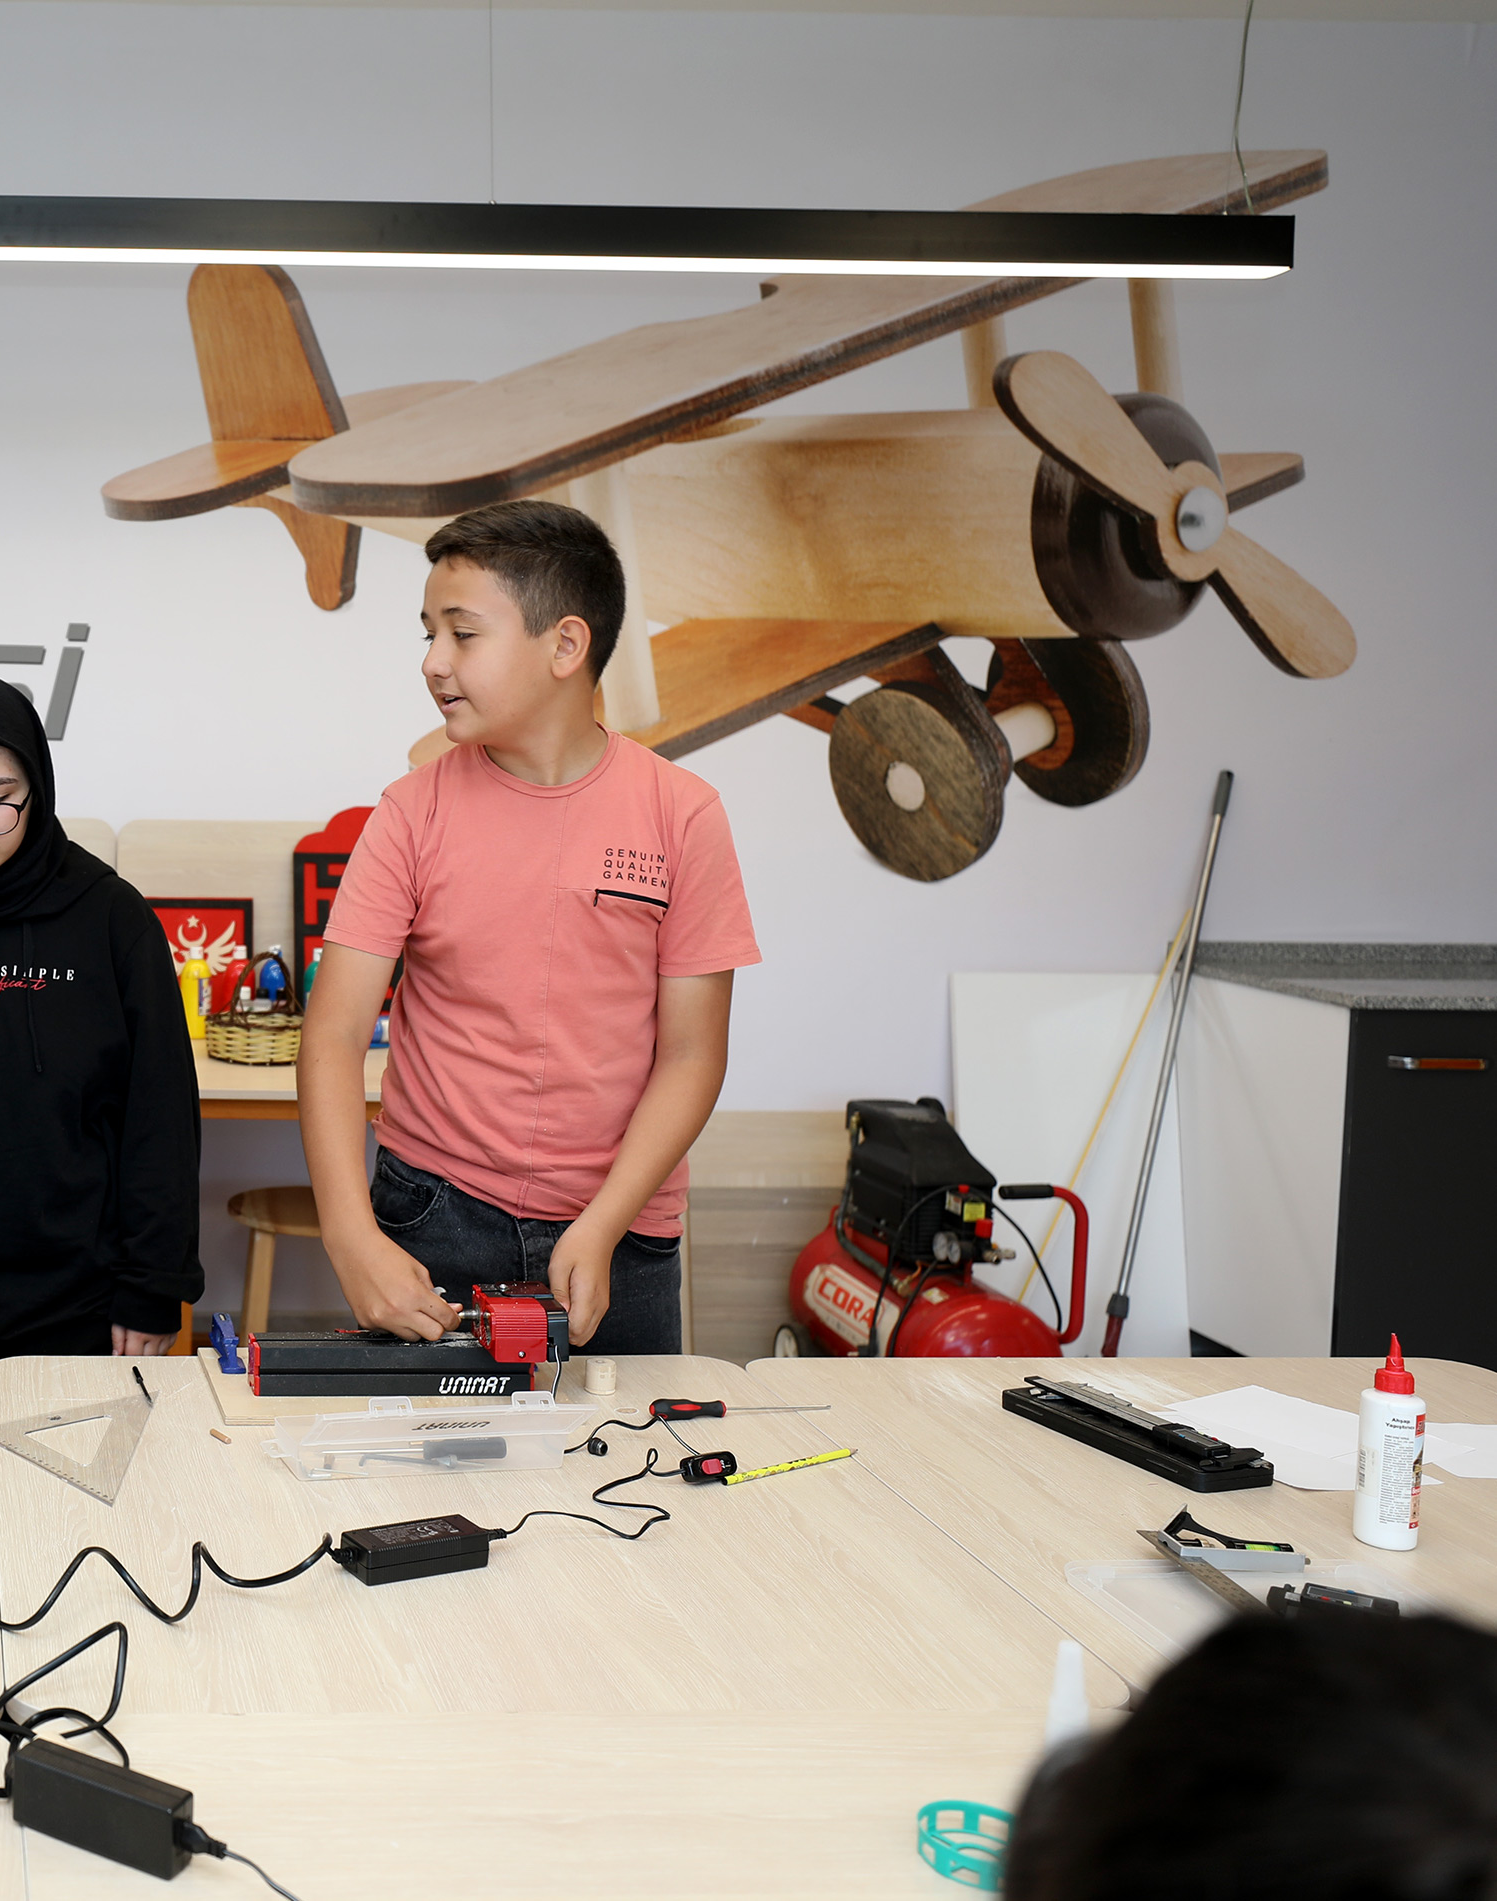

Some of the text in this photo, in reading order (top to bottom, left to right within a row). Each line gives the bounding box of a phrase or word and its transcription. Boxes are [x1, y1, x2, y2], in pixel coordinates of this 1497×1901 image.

[605, 847, 665, 864] GENUIN
[603, 870, 668, 889] GARMEN
[439, 1376, 511, 1394] UNIMAT
[411, 1421, 491, 1431] UNIMAT
